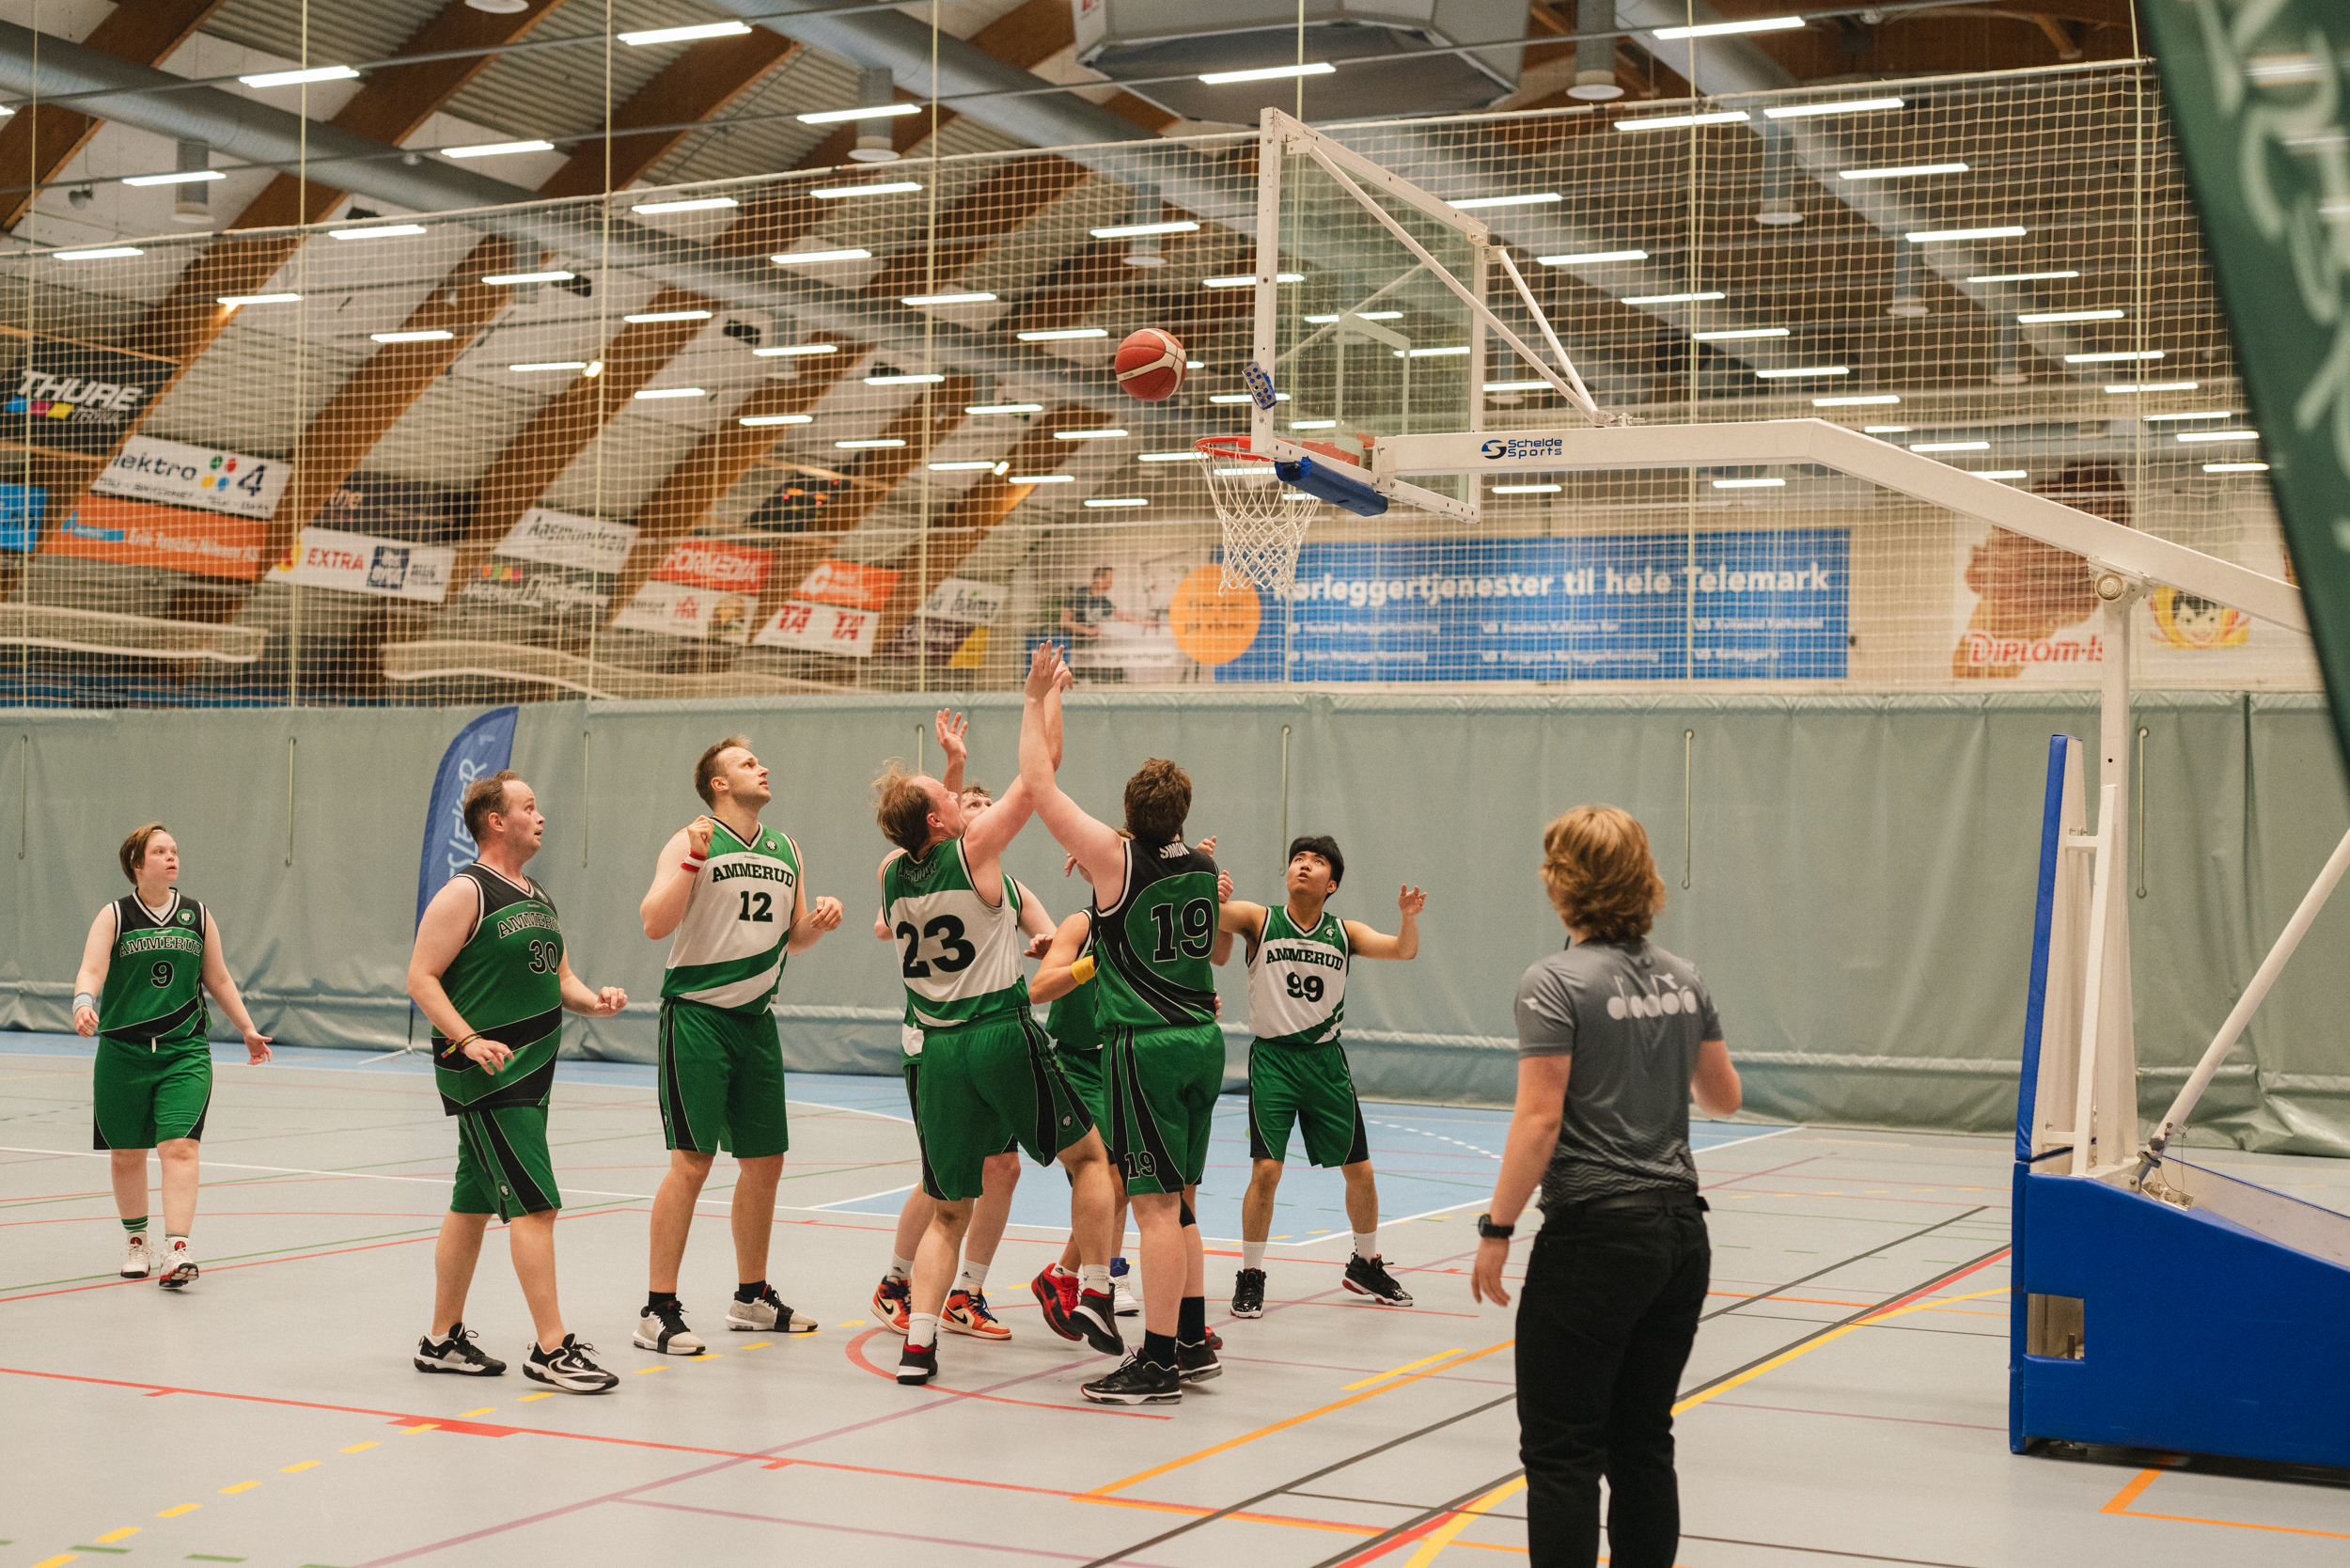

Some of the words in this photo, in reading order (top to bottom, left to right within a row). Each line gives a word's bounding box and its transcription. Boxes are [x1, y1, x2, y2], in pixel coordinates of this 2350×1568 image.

[17, 370, 143, 411] THURE
[1508, 438, 1562, 448] Schelde
[1508, 447, 1562, 459] Sports
[112, 451, 196, 481] lektro
[237, 464, 268, 496] 4
[307, 547, 364, 571] EXTRA
[1563, 567, 1595, 596] til
[1606, 566, 1672, 594] hele
[1683, 561, 1829, 592] Telemark
[1159, 841, 1190, 859] SIMON
[713, 863, 793, 887] AMMERUD
[739, 890, 773, 922] 12
[496, 911, 561, 939] AMMERU
[1151, 897, 1214, 963] 19
[118, 936, 203, 958] AMMERUD
[528, 939, 557, 975] 30
[896, 914, 976, 980] 23
[1265, 948, 1343, 971] AMMERUD
[150, 960, 174, 988] 9
[1286, 971, 1324, 1003] 99
[1124, 1151, 1156, 1179] 19
